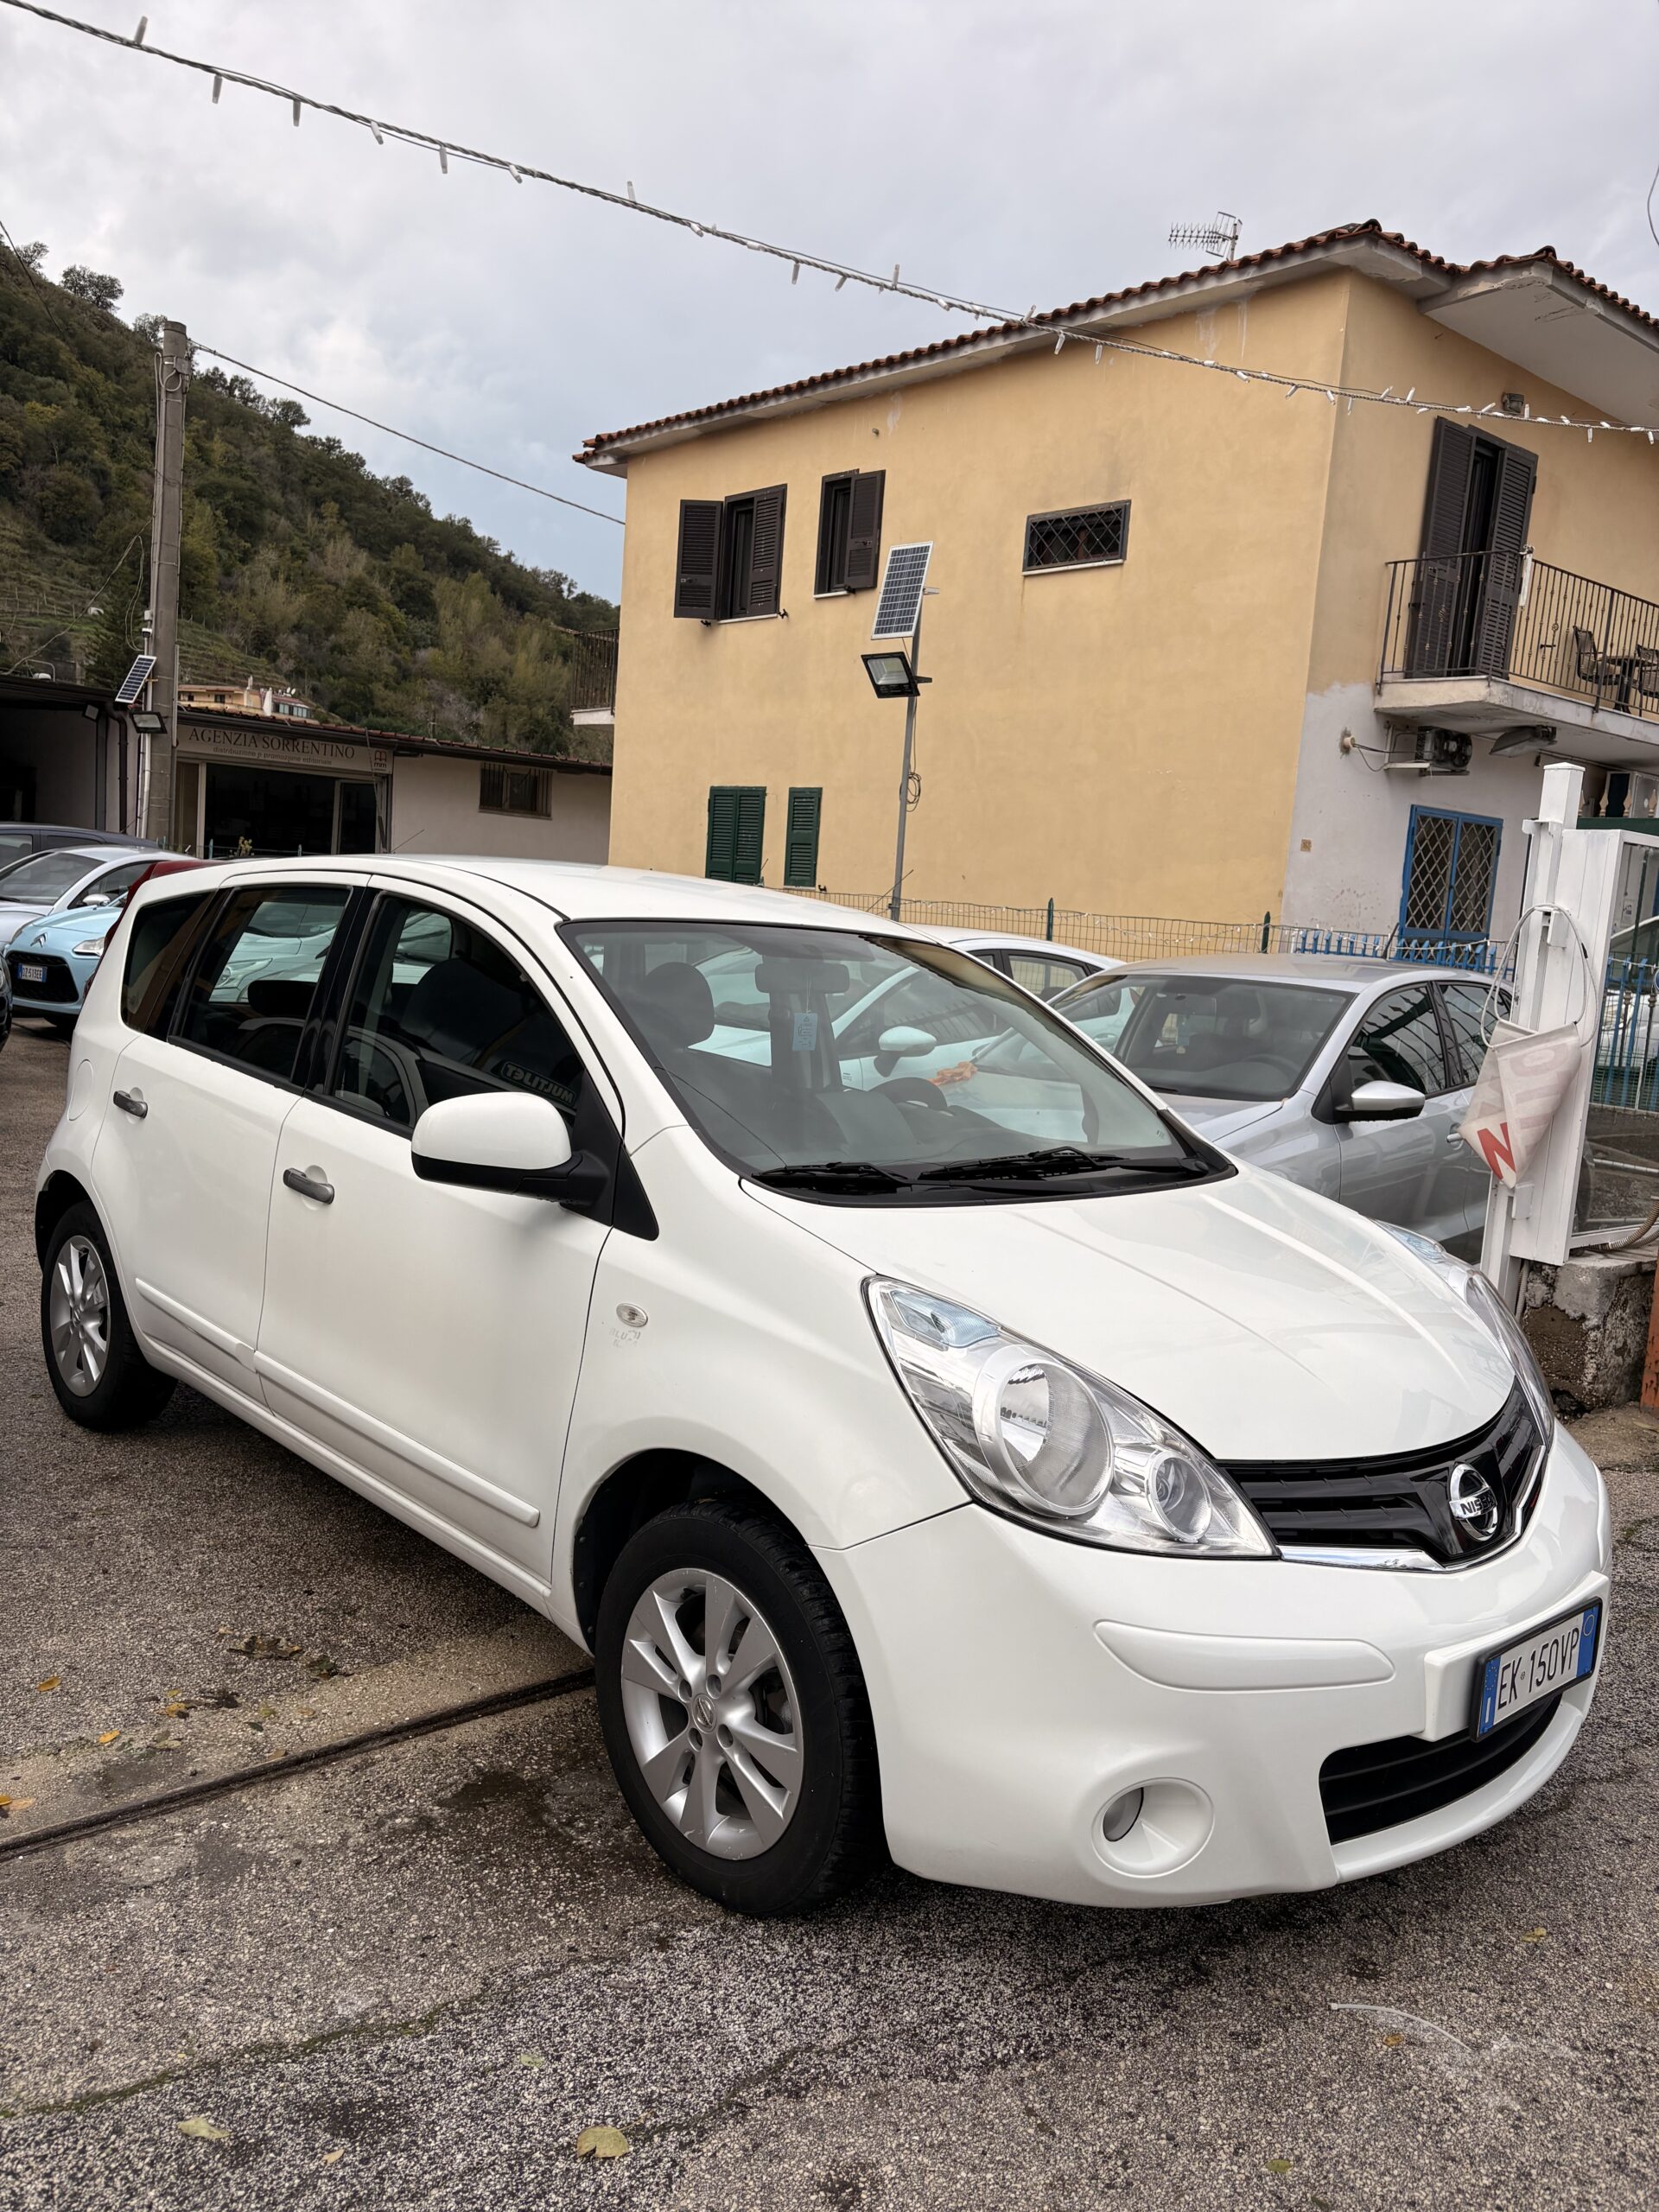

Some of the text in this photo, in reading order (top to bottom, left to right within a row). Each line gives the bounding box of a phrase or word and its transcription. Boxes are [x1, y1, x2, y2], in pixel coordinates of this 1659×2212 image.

[188, 727, 355, 760] AGENZIA SORRENTINO
[1497, 1656, 1522, 1711] EK
[1529, 1627, 1580, 1694] 150VP
